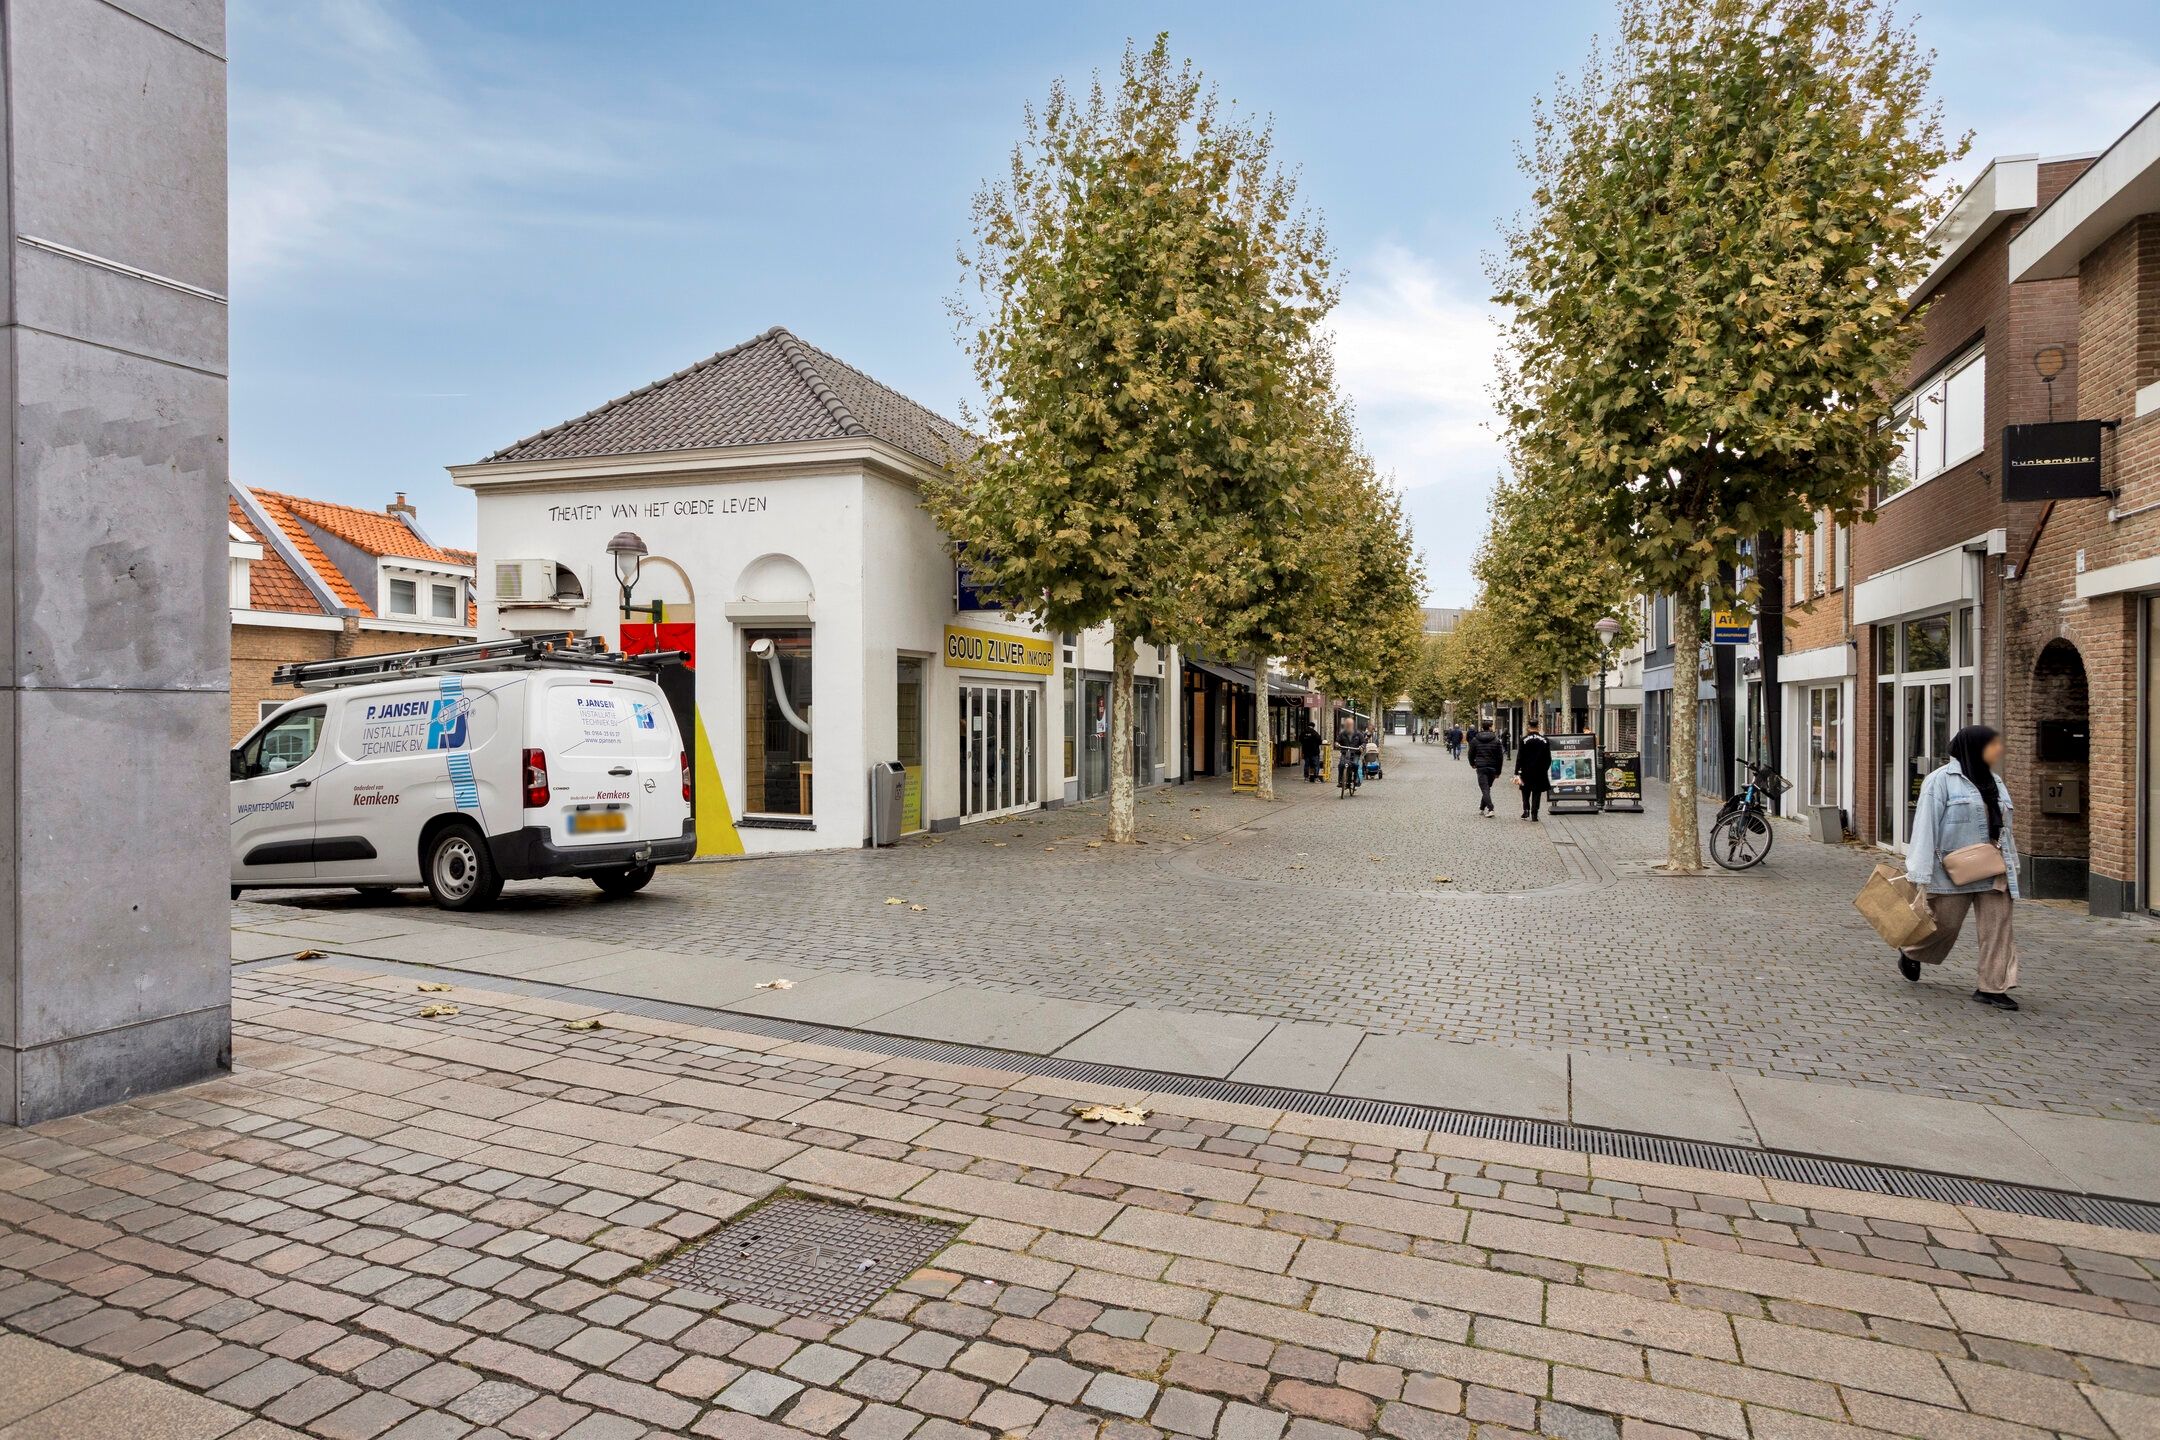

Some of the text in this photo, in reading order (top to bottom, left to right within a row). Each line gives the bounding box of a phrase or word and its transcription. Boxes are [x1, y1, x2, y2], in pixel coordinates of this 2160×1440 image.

[611, 503, 638, 518] VAN
[644, 501, 670, 517] HET
[673, 499, 714, 516] GOEDE
[722, 496, 767, 514] LEVEN
[948, 634, 1052, 667] GOUD ZILVER INKOOP
[378, 700, 430, 719] JANSEN
[586, 699, 615, 709] JANSEN
[580, 710, 617, 719] INSTALLATIE
[582, 718, 610, 727] TECHNIEK
[363, 723, 425, 740] INSTALLATIE
[362, 740, 408, 755] TECHNIEK
[353, 791, 400, 806] Kemkens
[596, 790, 630, 800] Kemkens
[2048, 786, 2064, 798] 37
[237, 800, 295, 814] WARMTEPOMPEN
